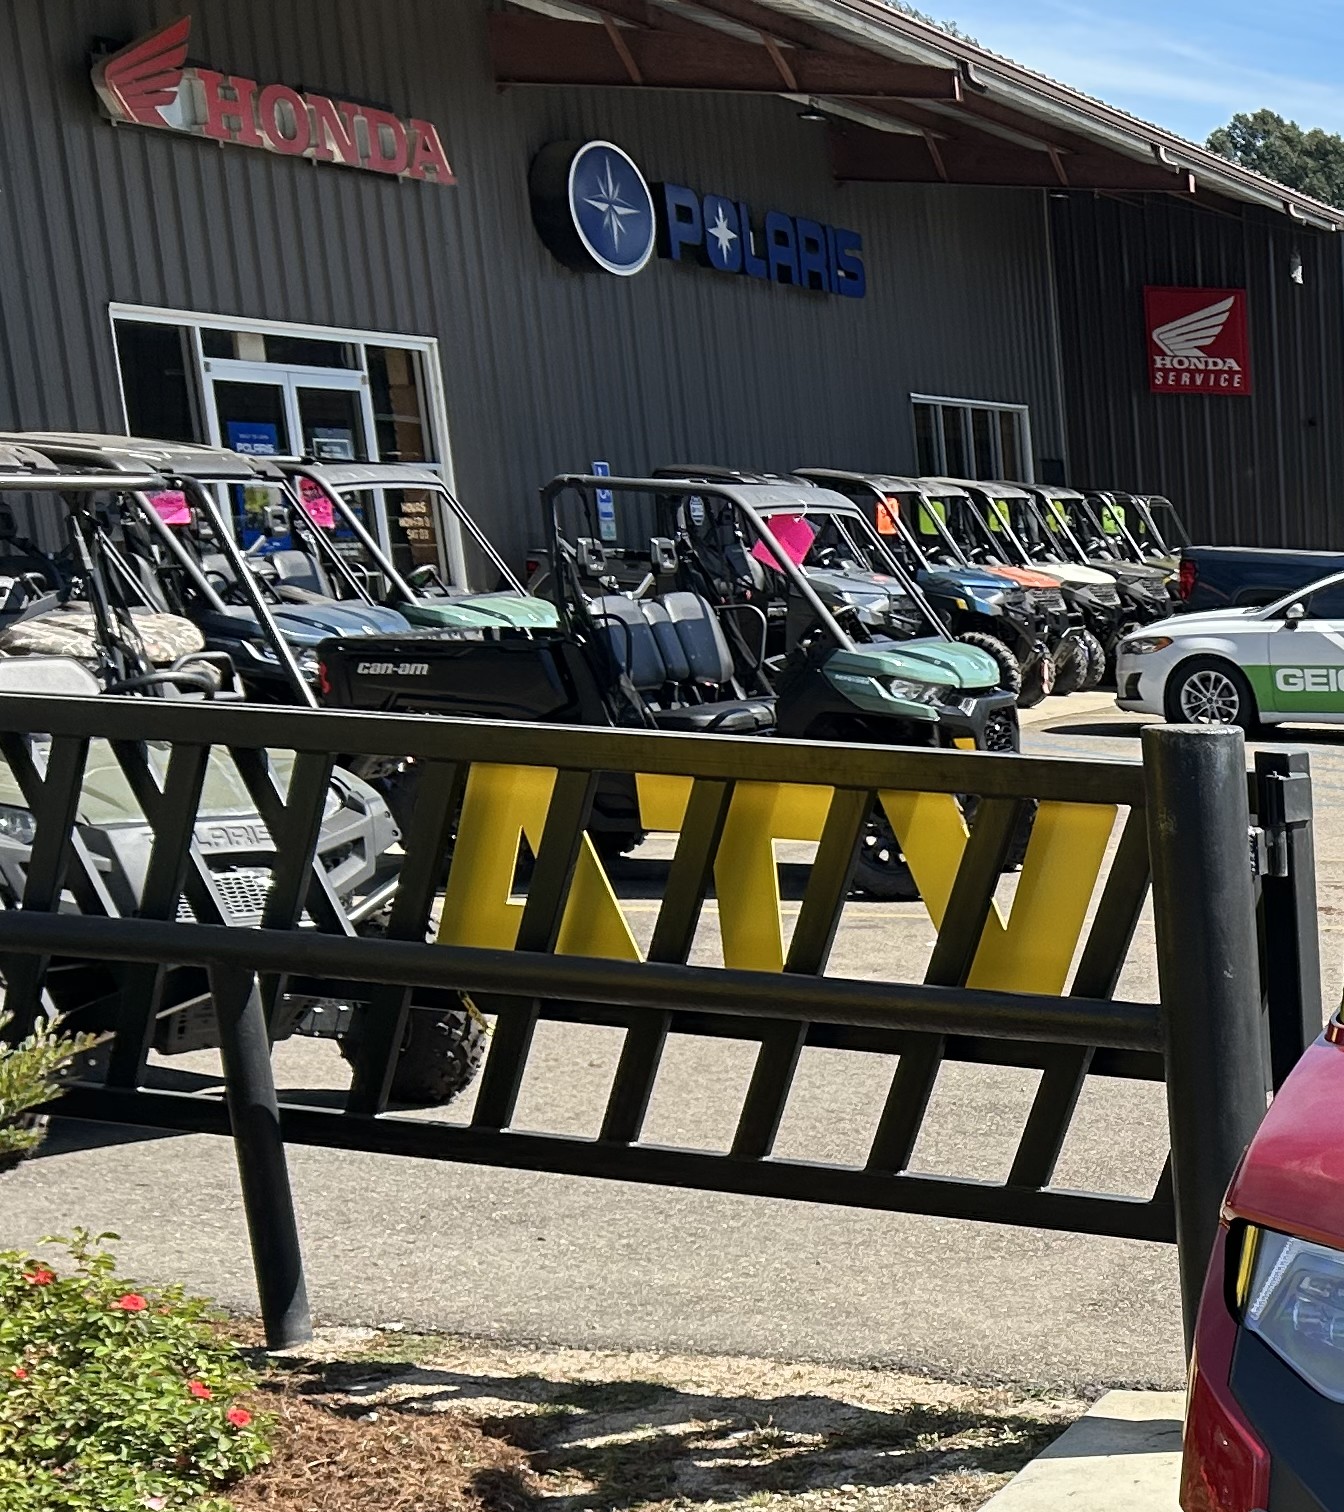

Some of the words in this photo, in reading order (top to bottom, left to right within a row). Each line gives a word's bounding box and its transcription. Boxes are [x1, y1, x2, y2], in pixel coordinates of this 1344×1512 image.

[195, 67, 457, 185] HONDA
[664, 182, 866, 298] POLARIS
[1153, 355, 1242, 371] HONDA
[1154, 372, 1242, 387] SERVICE
[357, 662, 429, 675] can-am
